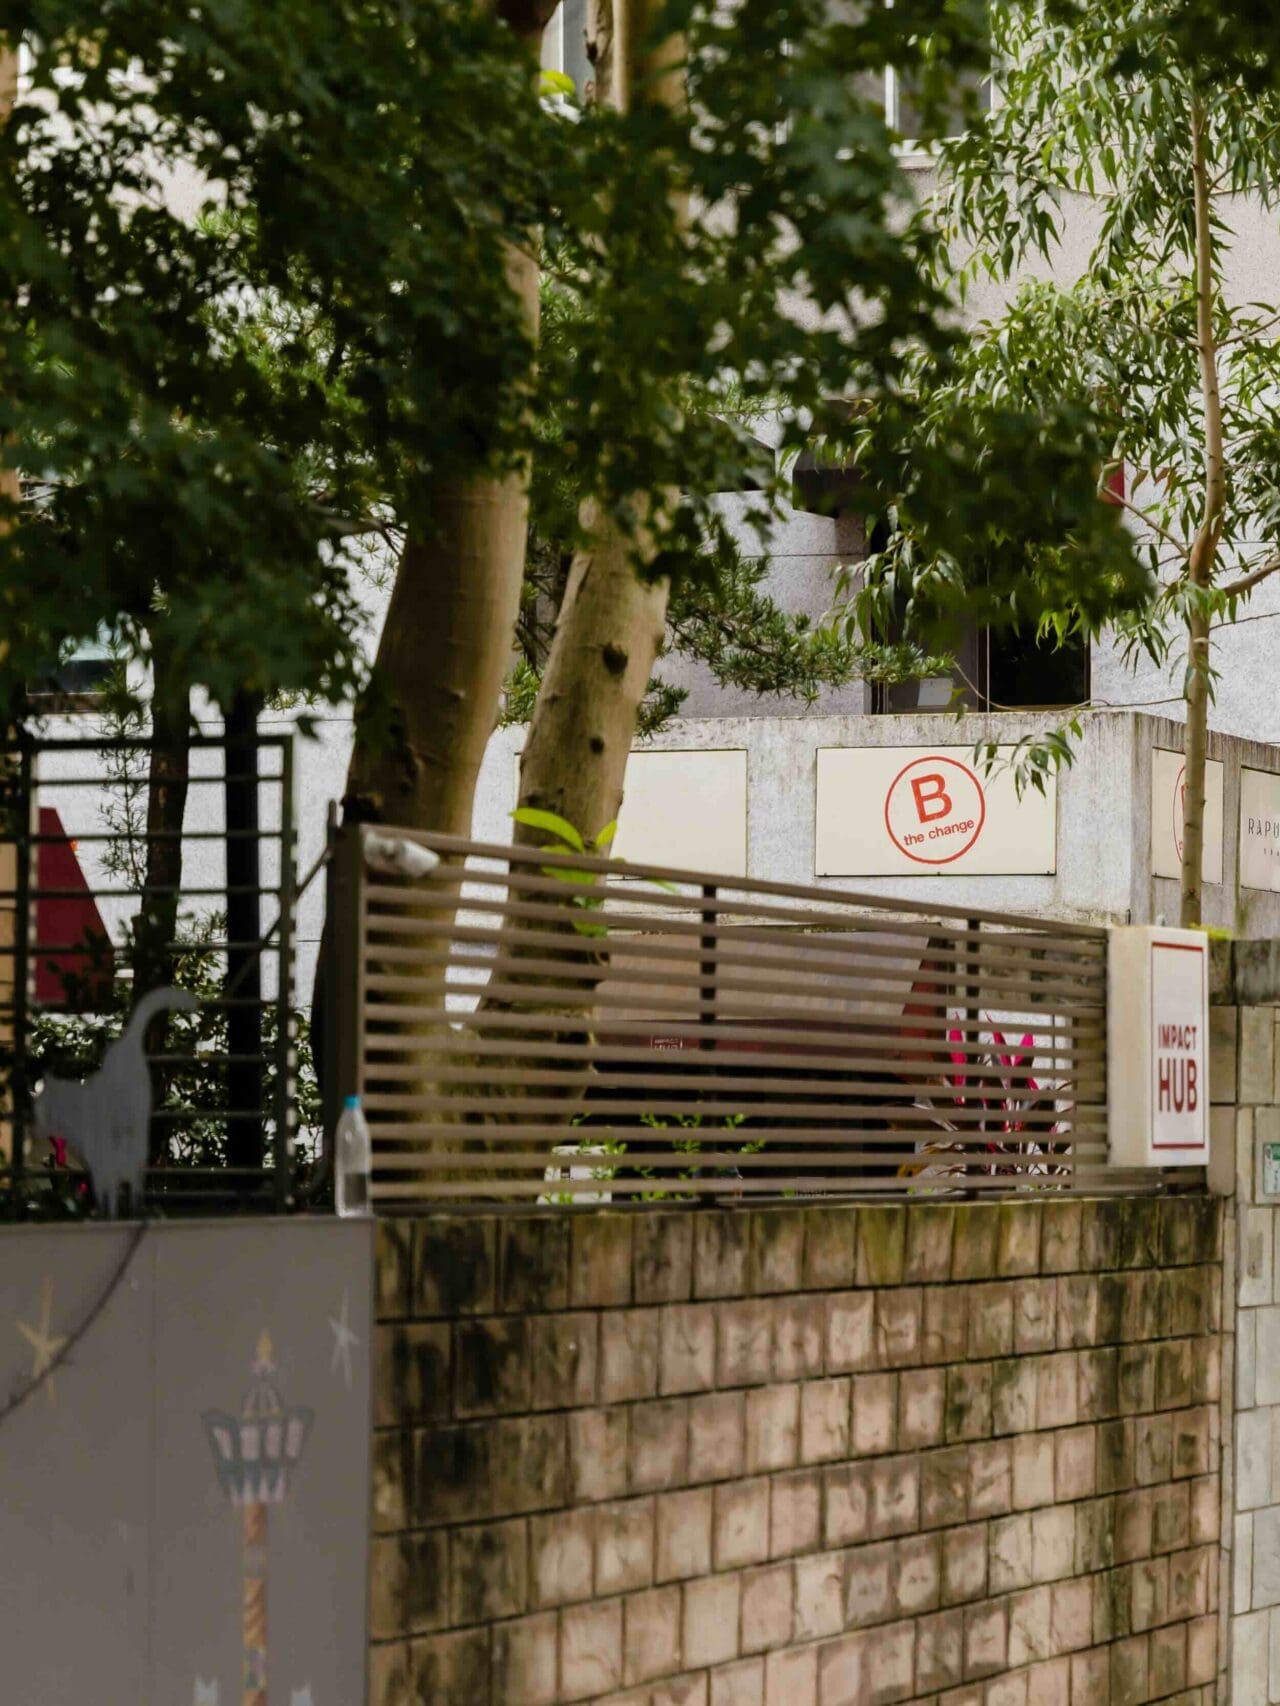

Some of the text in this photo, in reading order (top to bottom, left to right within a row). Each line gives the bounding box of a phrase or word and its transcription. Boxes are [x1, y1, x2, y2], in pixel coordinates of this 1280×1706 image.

[910, 773, 953, 824] B
[903, 819, 975, 846] the change
[1158, 1024, 1197, 1050] IMPACT
[1158, 1057, 1198, 1114] HUB
